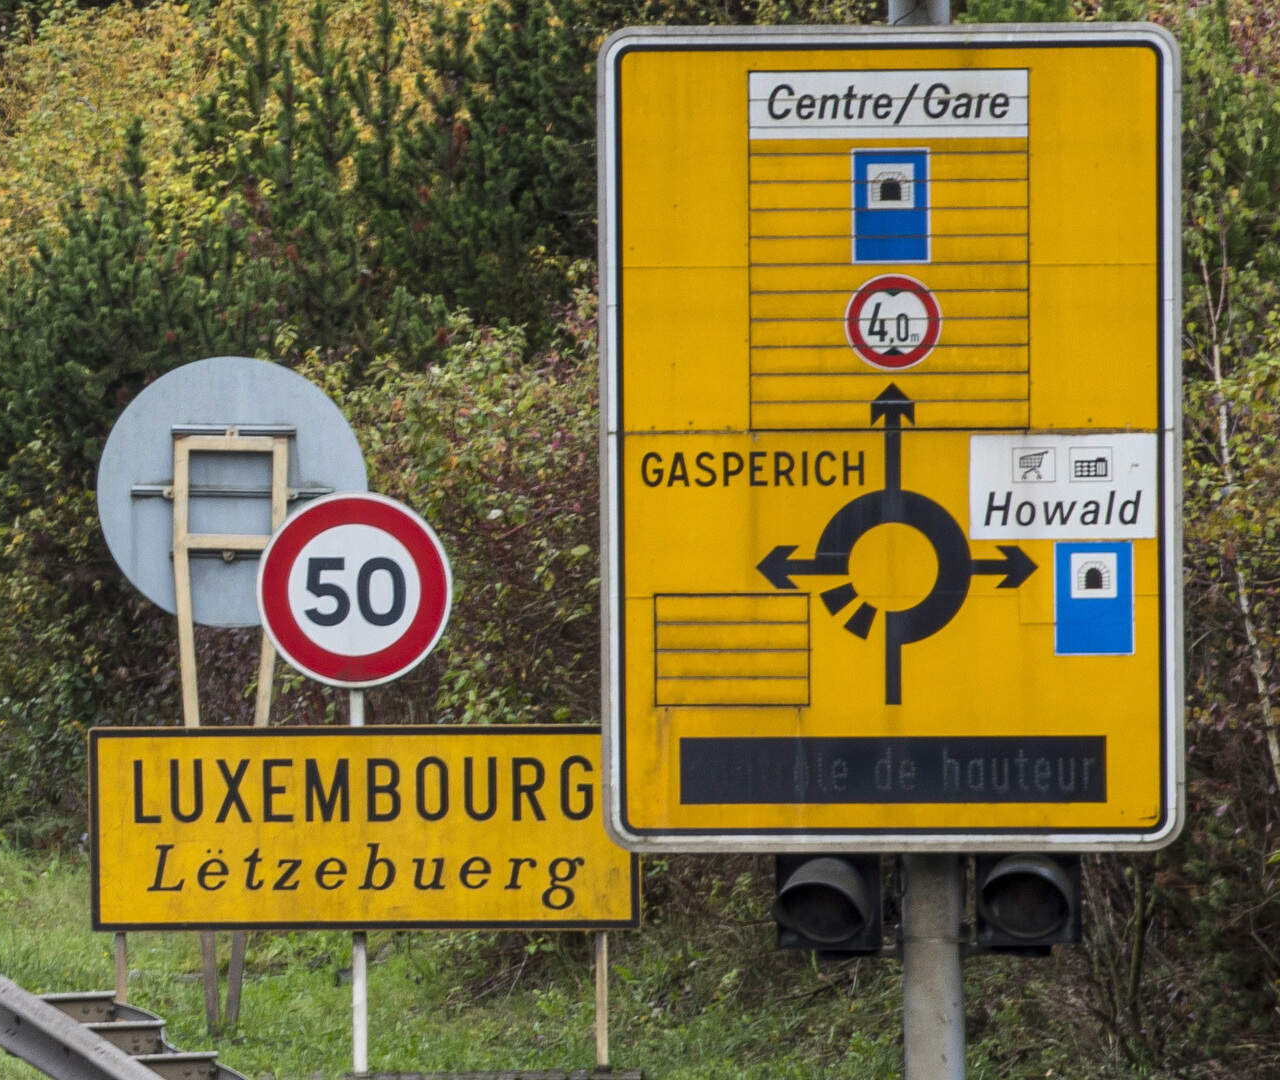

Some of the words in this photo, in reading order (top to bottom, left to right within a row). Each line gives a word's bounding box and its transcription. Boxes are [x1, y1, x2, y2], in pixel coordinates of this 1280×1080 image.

[767, 83, 1011, 125] Centre/Gare
[640, 450, 866, 489] GASPERICH
[983, 489, 1144, 528] Howald
[304, 556, 407, 628] 50
[132, 755, 594, 825] LUXEMBOURG
[942, 749, 1096, 793] hauteur
[146, 842, 586, 912] Lëtzebuerg
